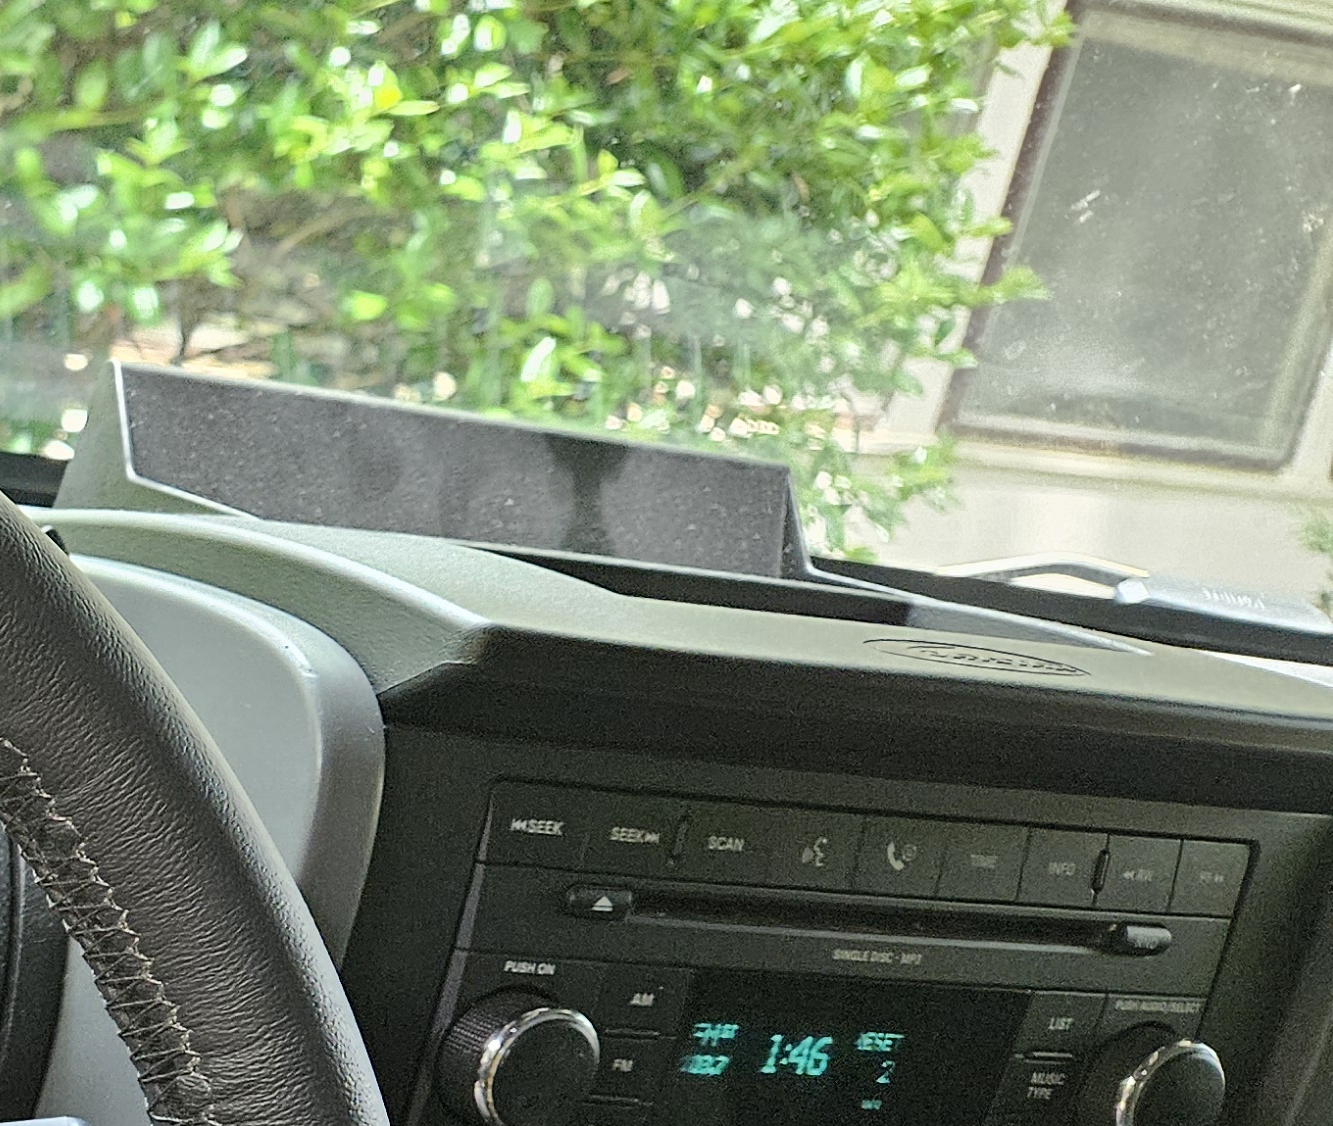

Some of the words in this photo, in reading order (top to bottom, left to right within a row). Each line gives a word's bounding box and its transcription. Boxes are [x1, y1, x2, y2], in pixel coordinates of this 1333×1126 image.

[528, 820, 562, 834] SEEK
[611, 828, 643, 842] SEEK
[709, 836, 743, 850] SCAN
[504, 960, 536, 973] PUSH
[536, 963, 555, 975] ON
[630, 993, 655, 1006] AM
[1048, 1016, 1073, 1030] LIST
[761, 1035, 832, 1075] 1:46
